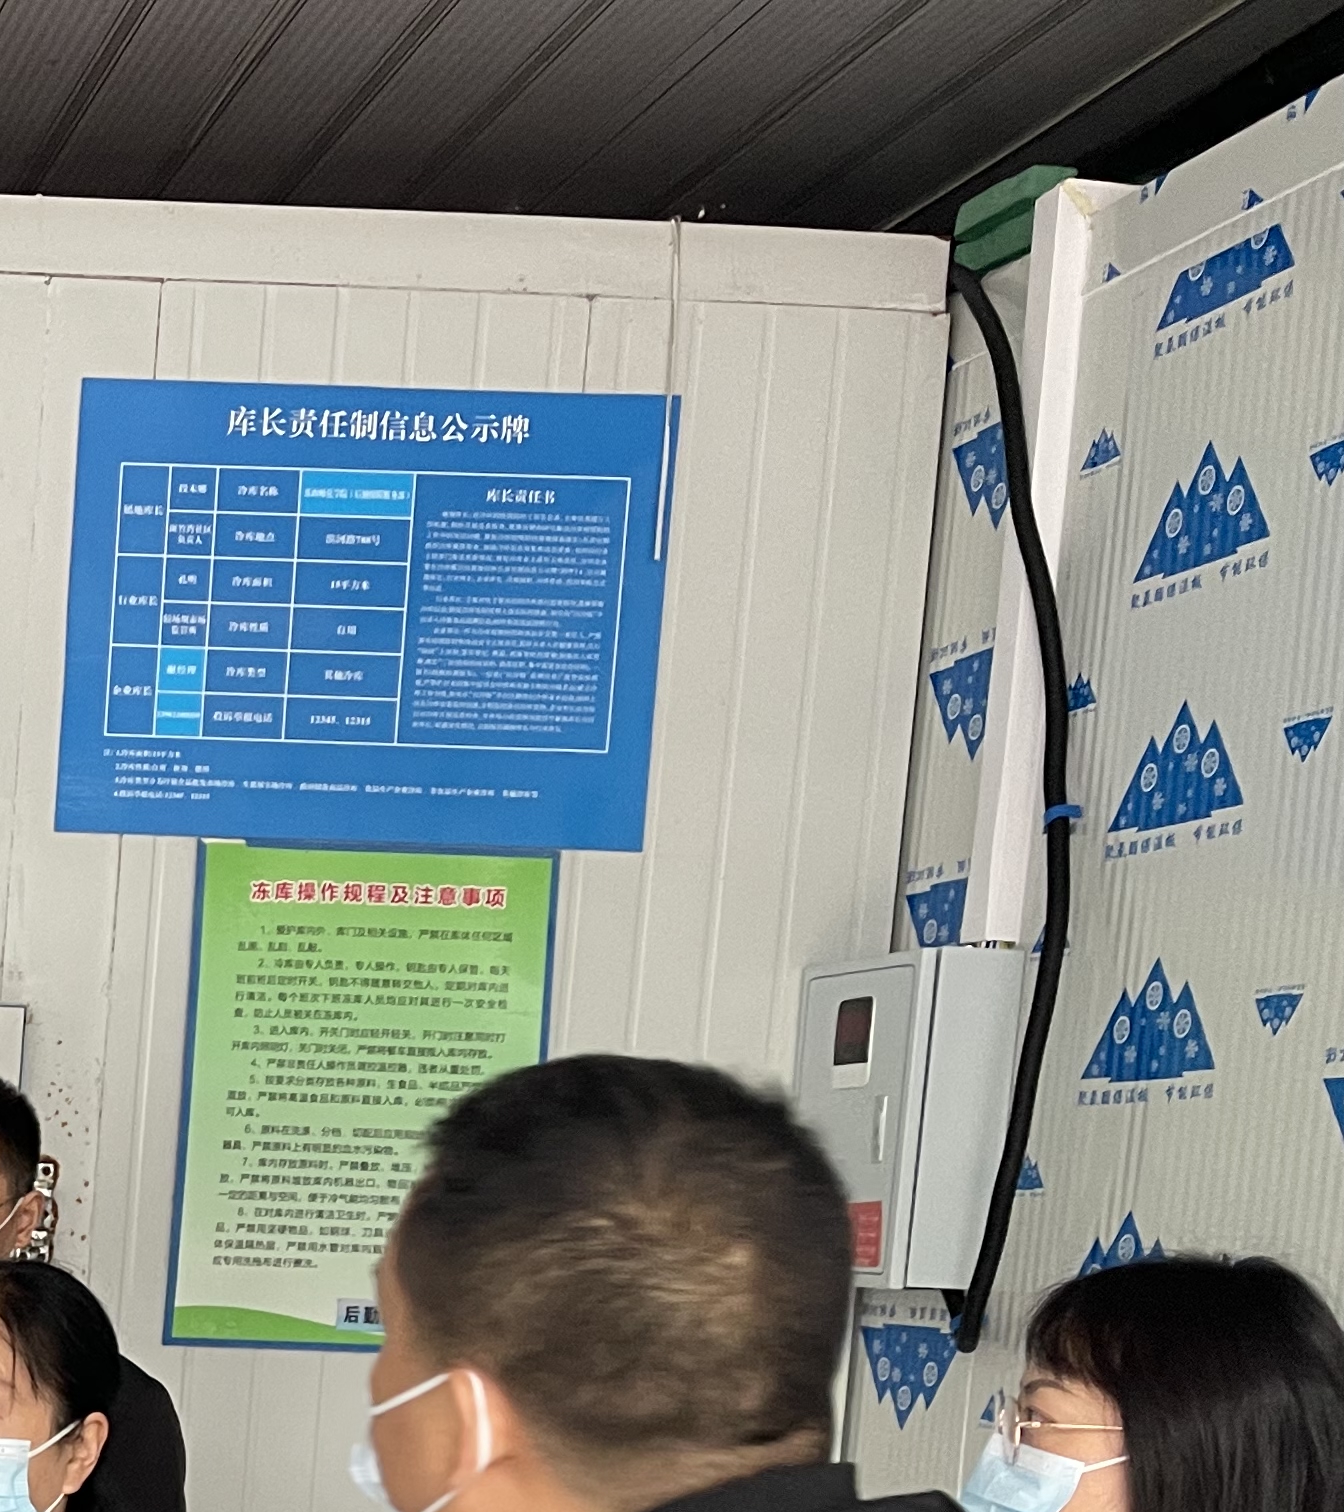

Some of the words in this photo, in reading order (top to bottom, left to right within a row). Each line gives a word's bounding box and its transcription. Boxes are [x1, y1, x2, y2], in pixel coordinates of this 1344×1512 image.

[226, 406, 530, 444] 库长责任制信息公示牌
[486, 488, 556, 505] 库长责任书
[252, 881, 507, 908] 冻库操作规程及注意事项
